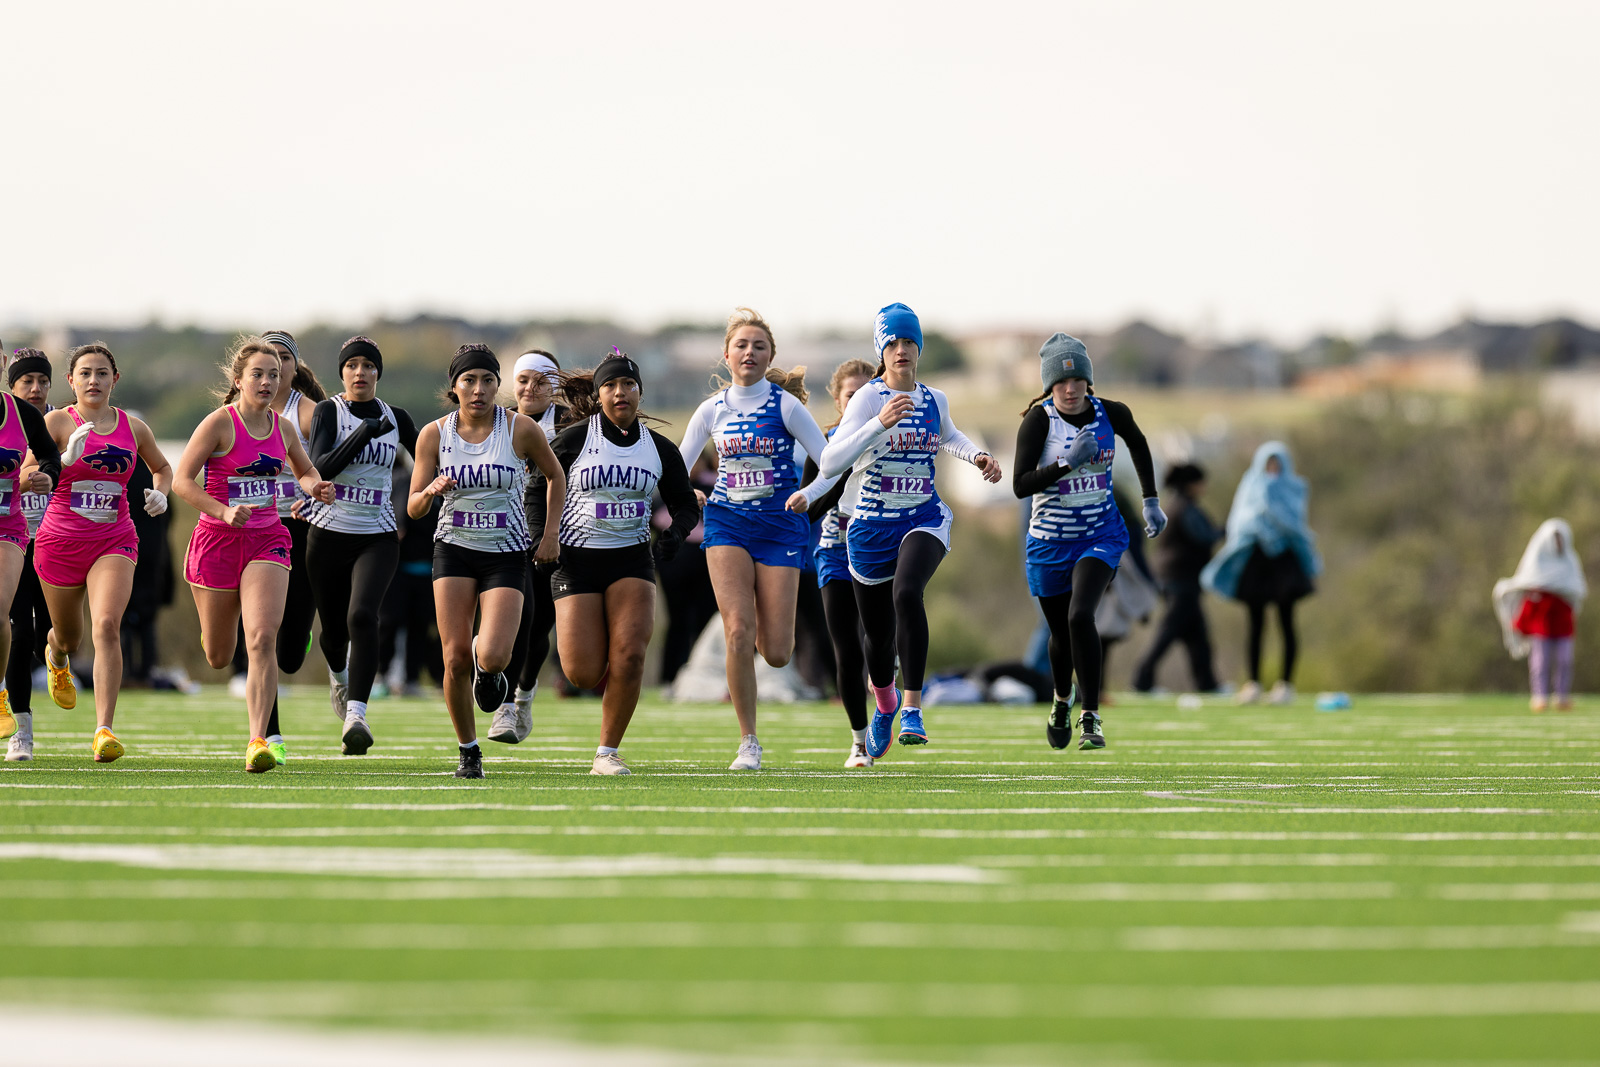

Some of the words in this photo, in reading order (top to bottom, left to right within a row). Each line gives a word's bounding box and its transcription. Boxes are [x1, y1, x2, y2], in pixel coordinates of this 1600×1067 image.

[717, 437, 743, 457] LADY
[746, 436, 774, 455] CATS
[890, 432, 917, 452] LADY
[734, 471, 765, 488] 1119
[891, 477, 924, 494] 1122
[1068, 476, 1100, 493] 1121
[239, 480, 268, 497] 1133
[342, 486, 375, 504] 1164
[20, 494, 48, 510] 160
[80, 493, 114, 509] 1132
[606, 502, 637, 519] 1163
[462, 512, 498, 528] 1159
